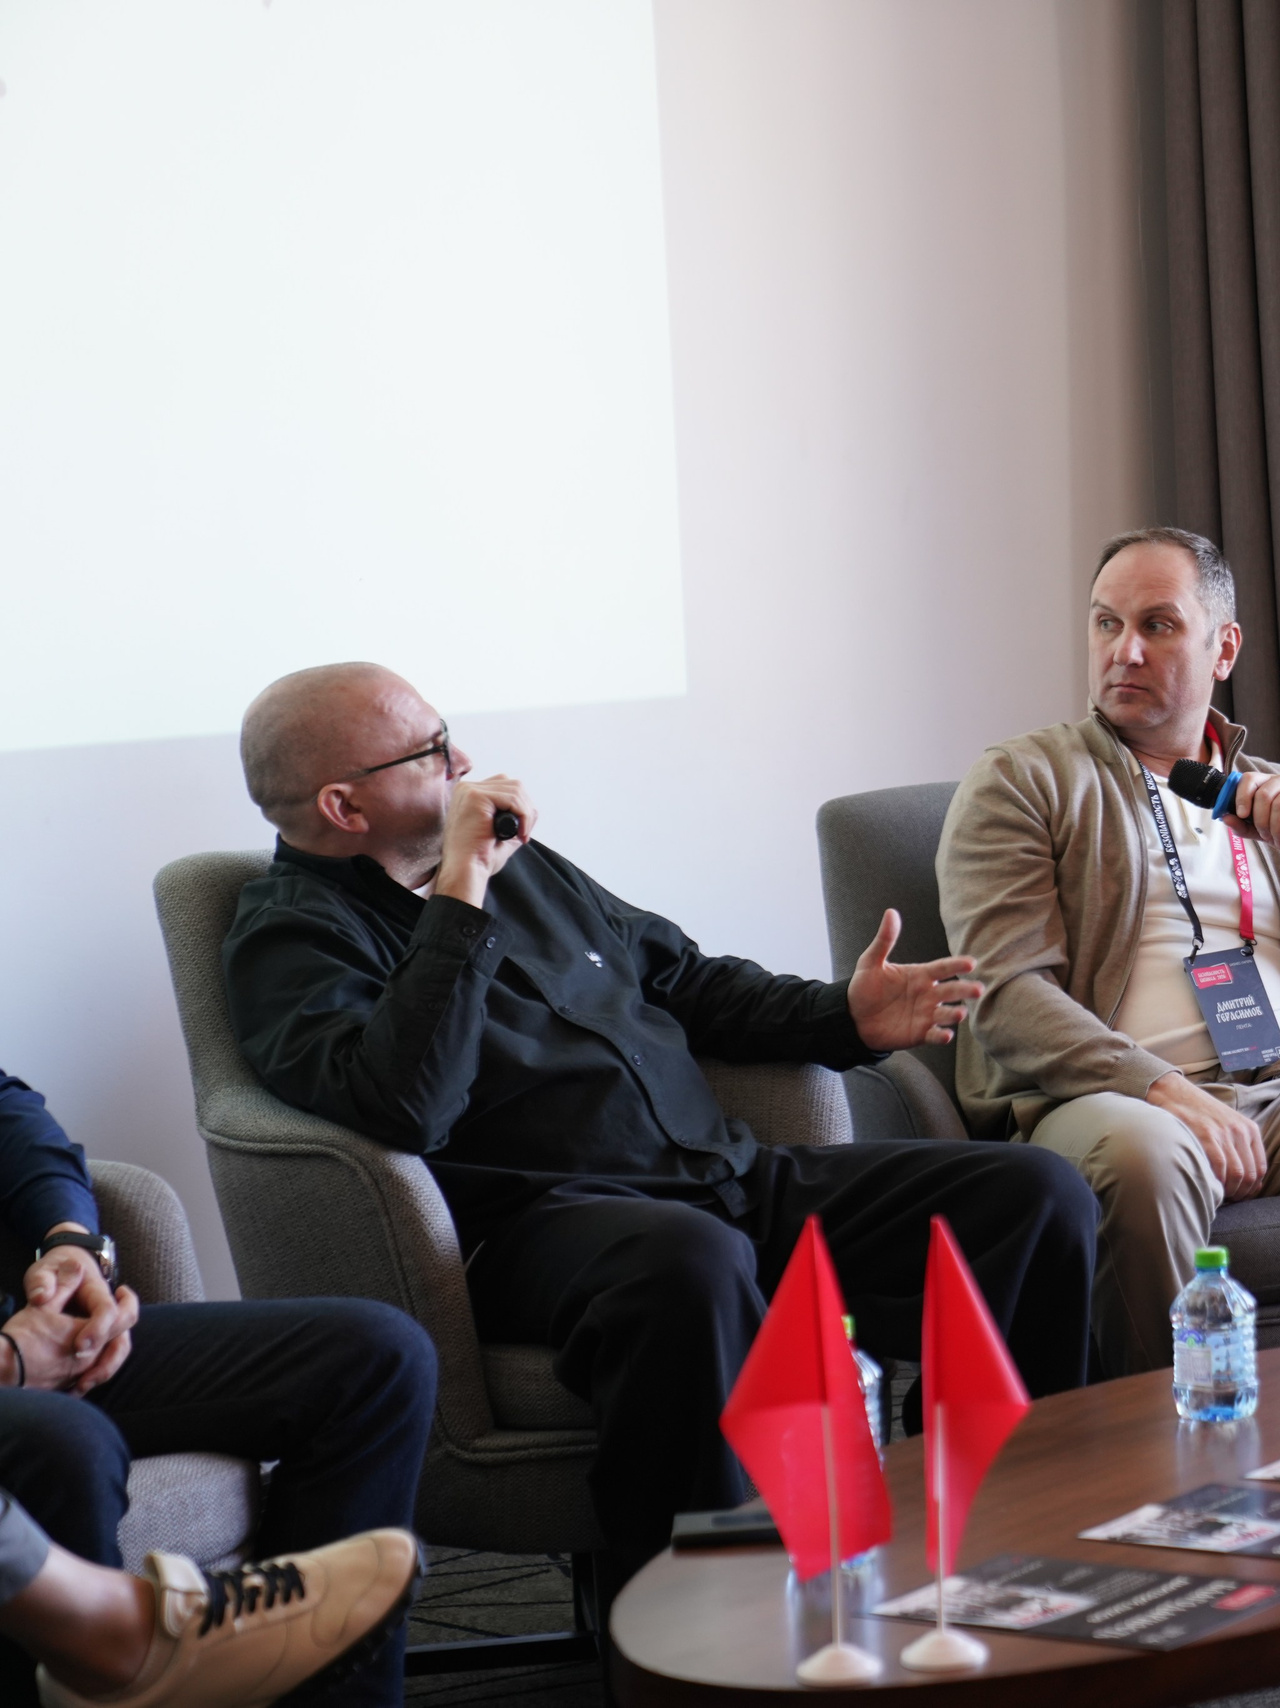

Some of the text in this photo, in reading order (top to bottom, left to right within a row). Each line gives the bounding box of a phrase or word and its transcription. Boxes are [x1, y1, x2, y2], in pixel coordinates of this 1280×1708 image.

[1151, 794, 1175, 853] БЕЗОПАСНОСТЬ
[1217, 994, 1256, 1013] ДМИТРИЙ
[1215, 1006, 1263, 1024] ГЕРАСИМОВ
